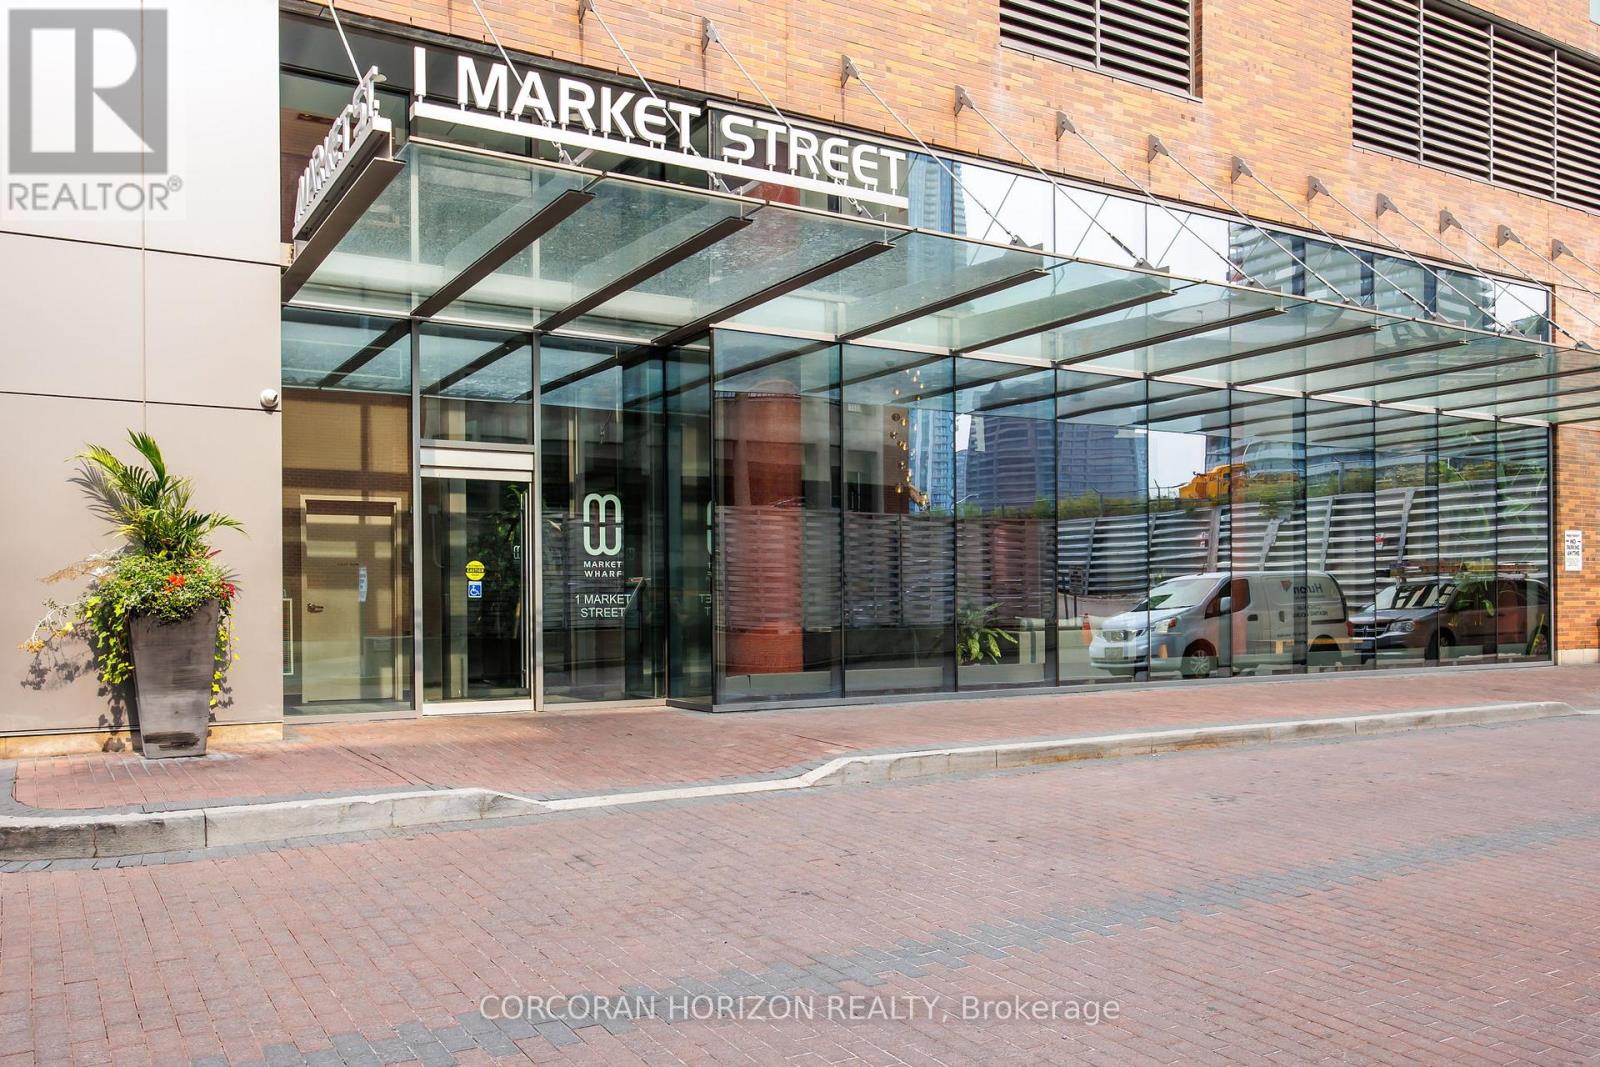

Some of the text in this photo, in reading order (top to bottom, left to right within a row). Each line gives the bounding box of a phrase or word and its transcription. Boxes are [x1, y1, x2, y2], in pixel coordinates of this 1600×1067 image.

[457, 55, 701, 149] MARKET
[720, 114, 906, 190] STREET
[583, 560, 622, 568] MARKET
[584, 570, 623, 578] WHARF
[575, 594, 632, 605] 1 MARKET
[580, 607, 626, 618] STREET
